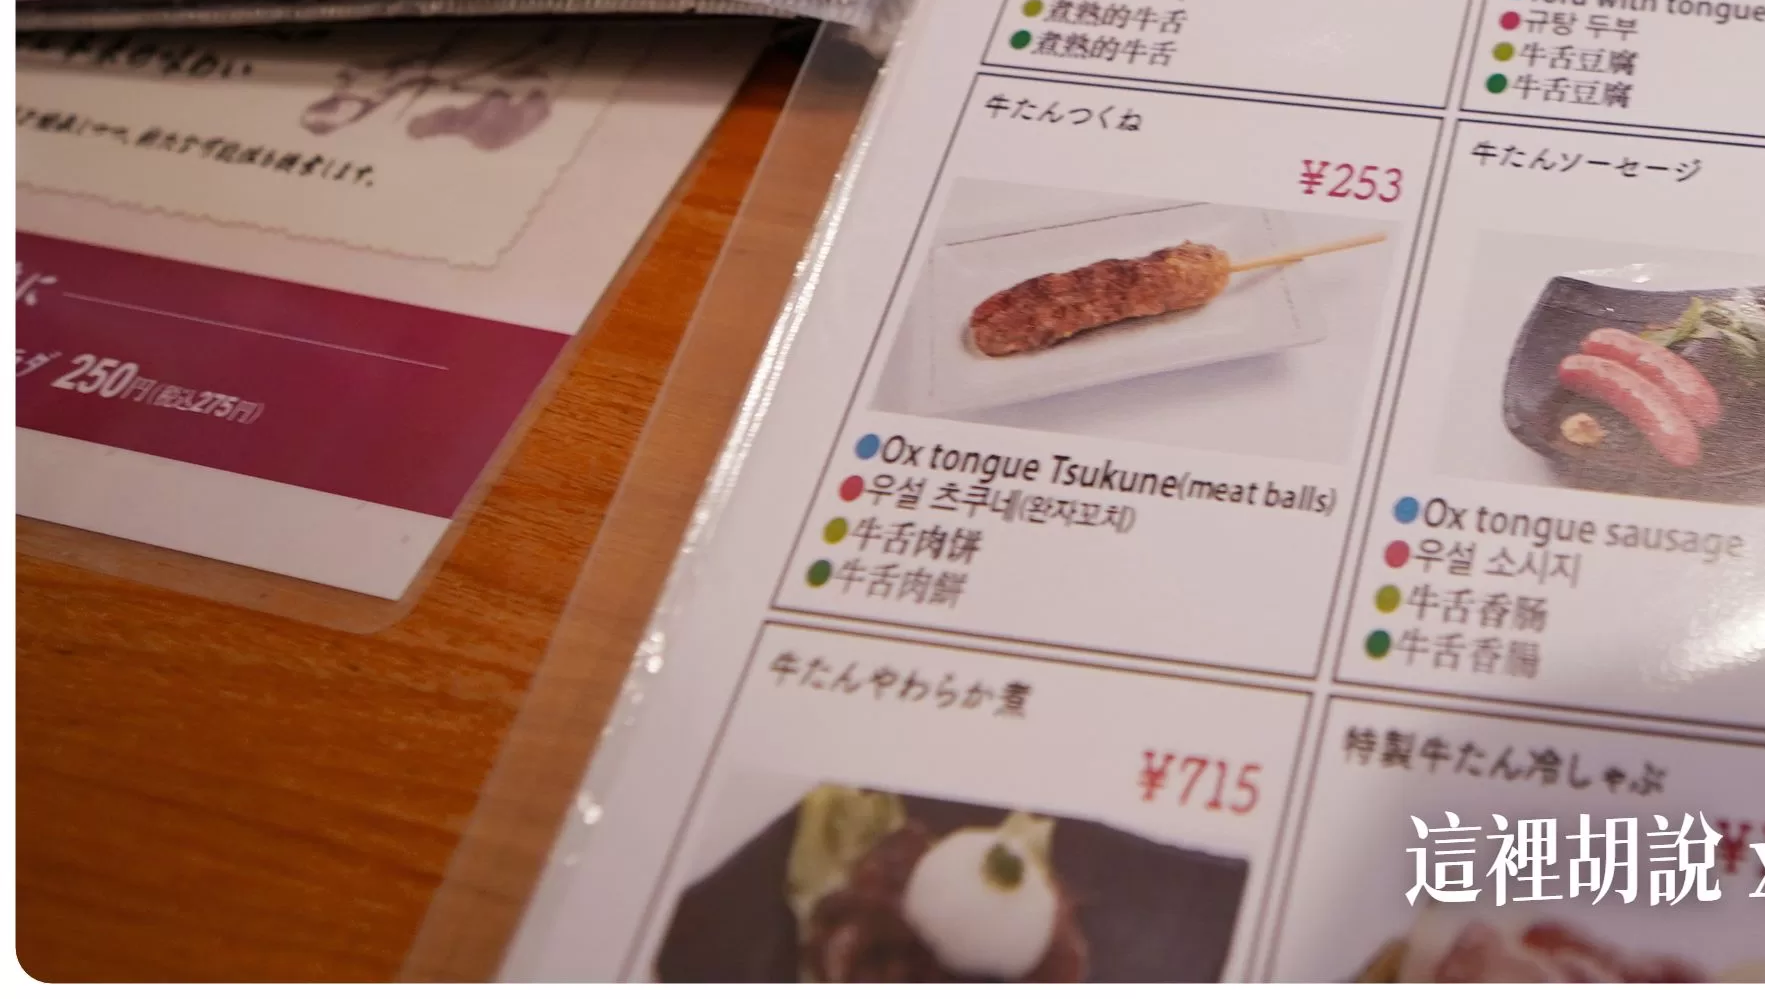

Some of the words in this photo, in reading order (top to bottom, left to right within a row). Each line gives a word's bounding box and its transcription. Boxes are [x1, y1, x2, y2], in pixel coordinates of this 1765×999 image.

[1030, 29, 1178, 67] 煮熟的牛舌
[1523, 12, 1578, 37] 규탕
[1585, 13, 1640, 40] 두부
[1518, 41, 1640, 77] 牛舌豆腐
[983, 93, 1144, 134] 牛たんつくね
[1511, 72, 1634, 110] 牛舌豆腐
[1298, 156, 1405, 204] ¥253
[1469, 139, 1705, 184] 牛たんソーセージ
[865, 471, 929, 511] 우설
[880, 434, 923, 468] Ox
[930, 442, 1041, 487] tongue
[1051, 451, 1261, 509] Tsukune(meat
[1264, 481, 1338, 518] balls)
[849, 515, 985, 566] 牛舌肉饼
[1421, 498, 1469, 532] Ox
[1476, 503, 1598, 548] tongue
[1603, 518, 1749, 565] sausage
[1412, 537, 1478, 578] 우설
[1483, 542, 1584, 590] 소시지
[1407, 582, 1549, 635] 牛舌香肠
[769, 649, 1033, 718] 牛たんやわらか煮
[1138, 748, 1263, 815] ¥715
[1343, 725, 1670, 797] 特製牛たん冷しゃぶ
